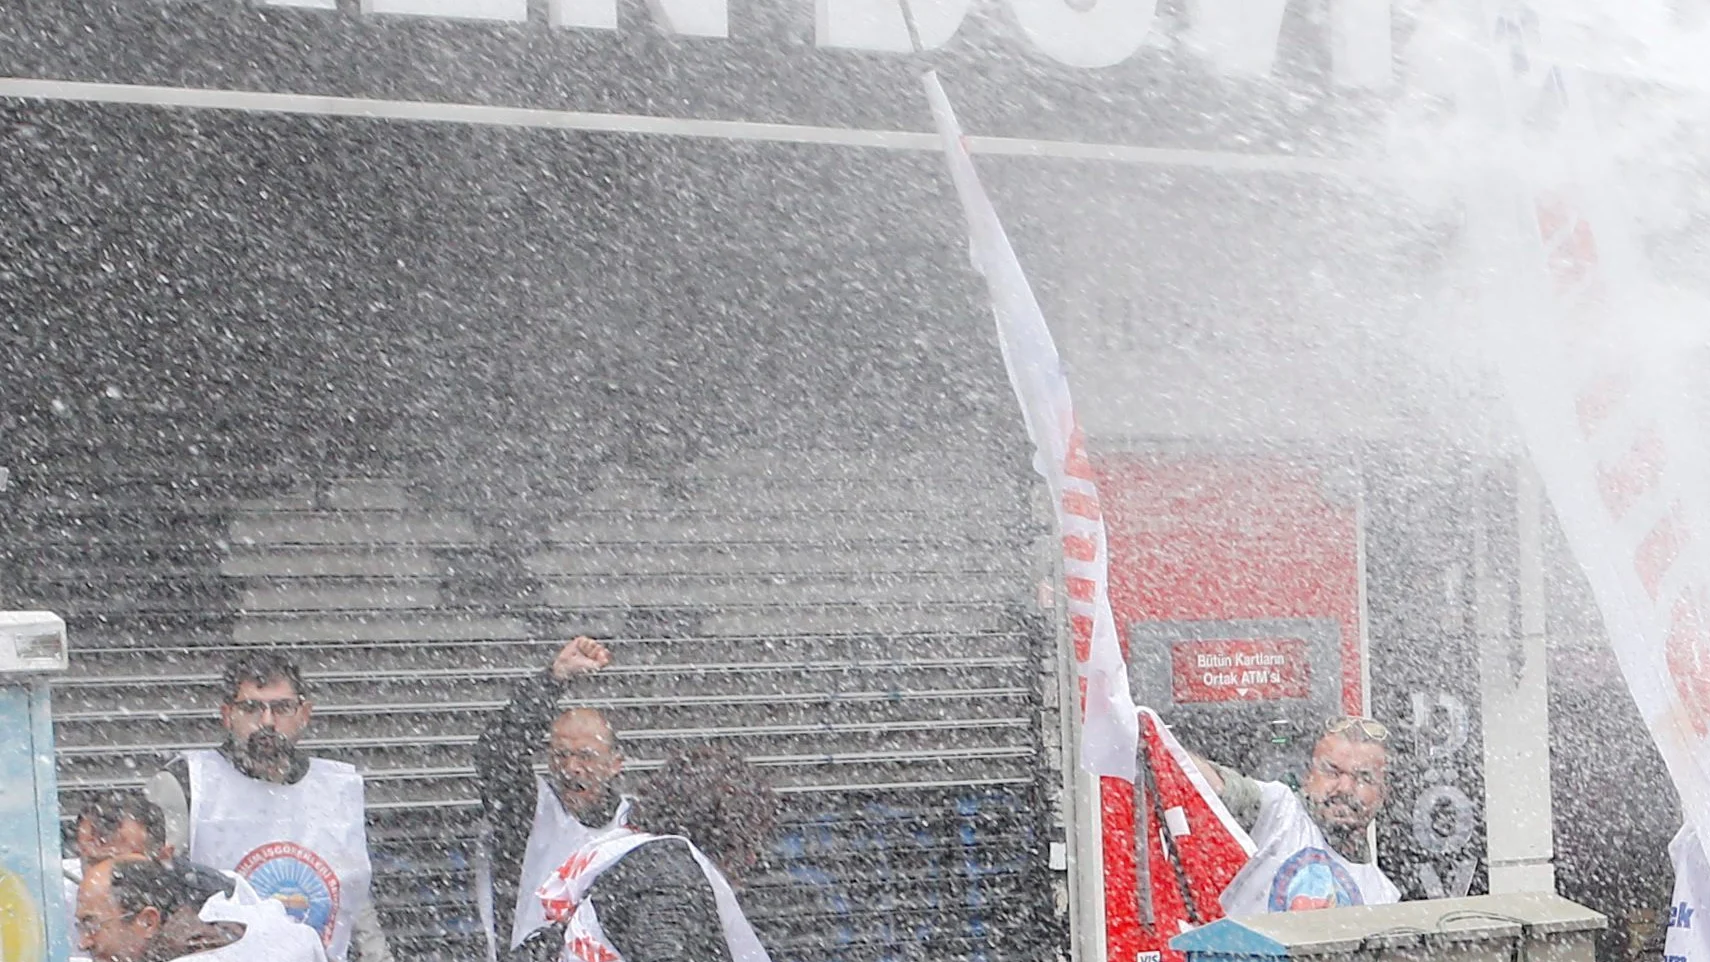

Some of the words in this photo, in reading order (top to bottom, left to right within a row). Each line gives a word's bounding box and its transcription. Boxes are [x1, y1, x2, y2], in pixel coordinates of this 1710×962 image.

[1196, 653, 1232, 668] Bütün
[1235, 652, 1285, 667] Kartların
[1203, 672, 1238, 686] Ortak
